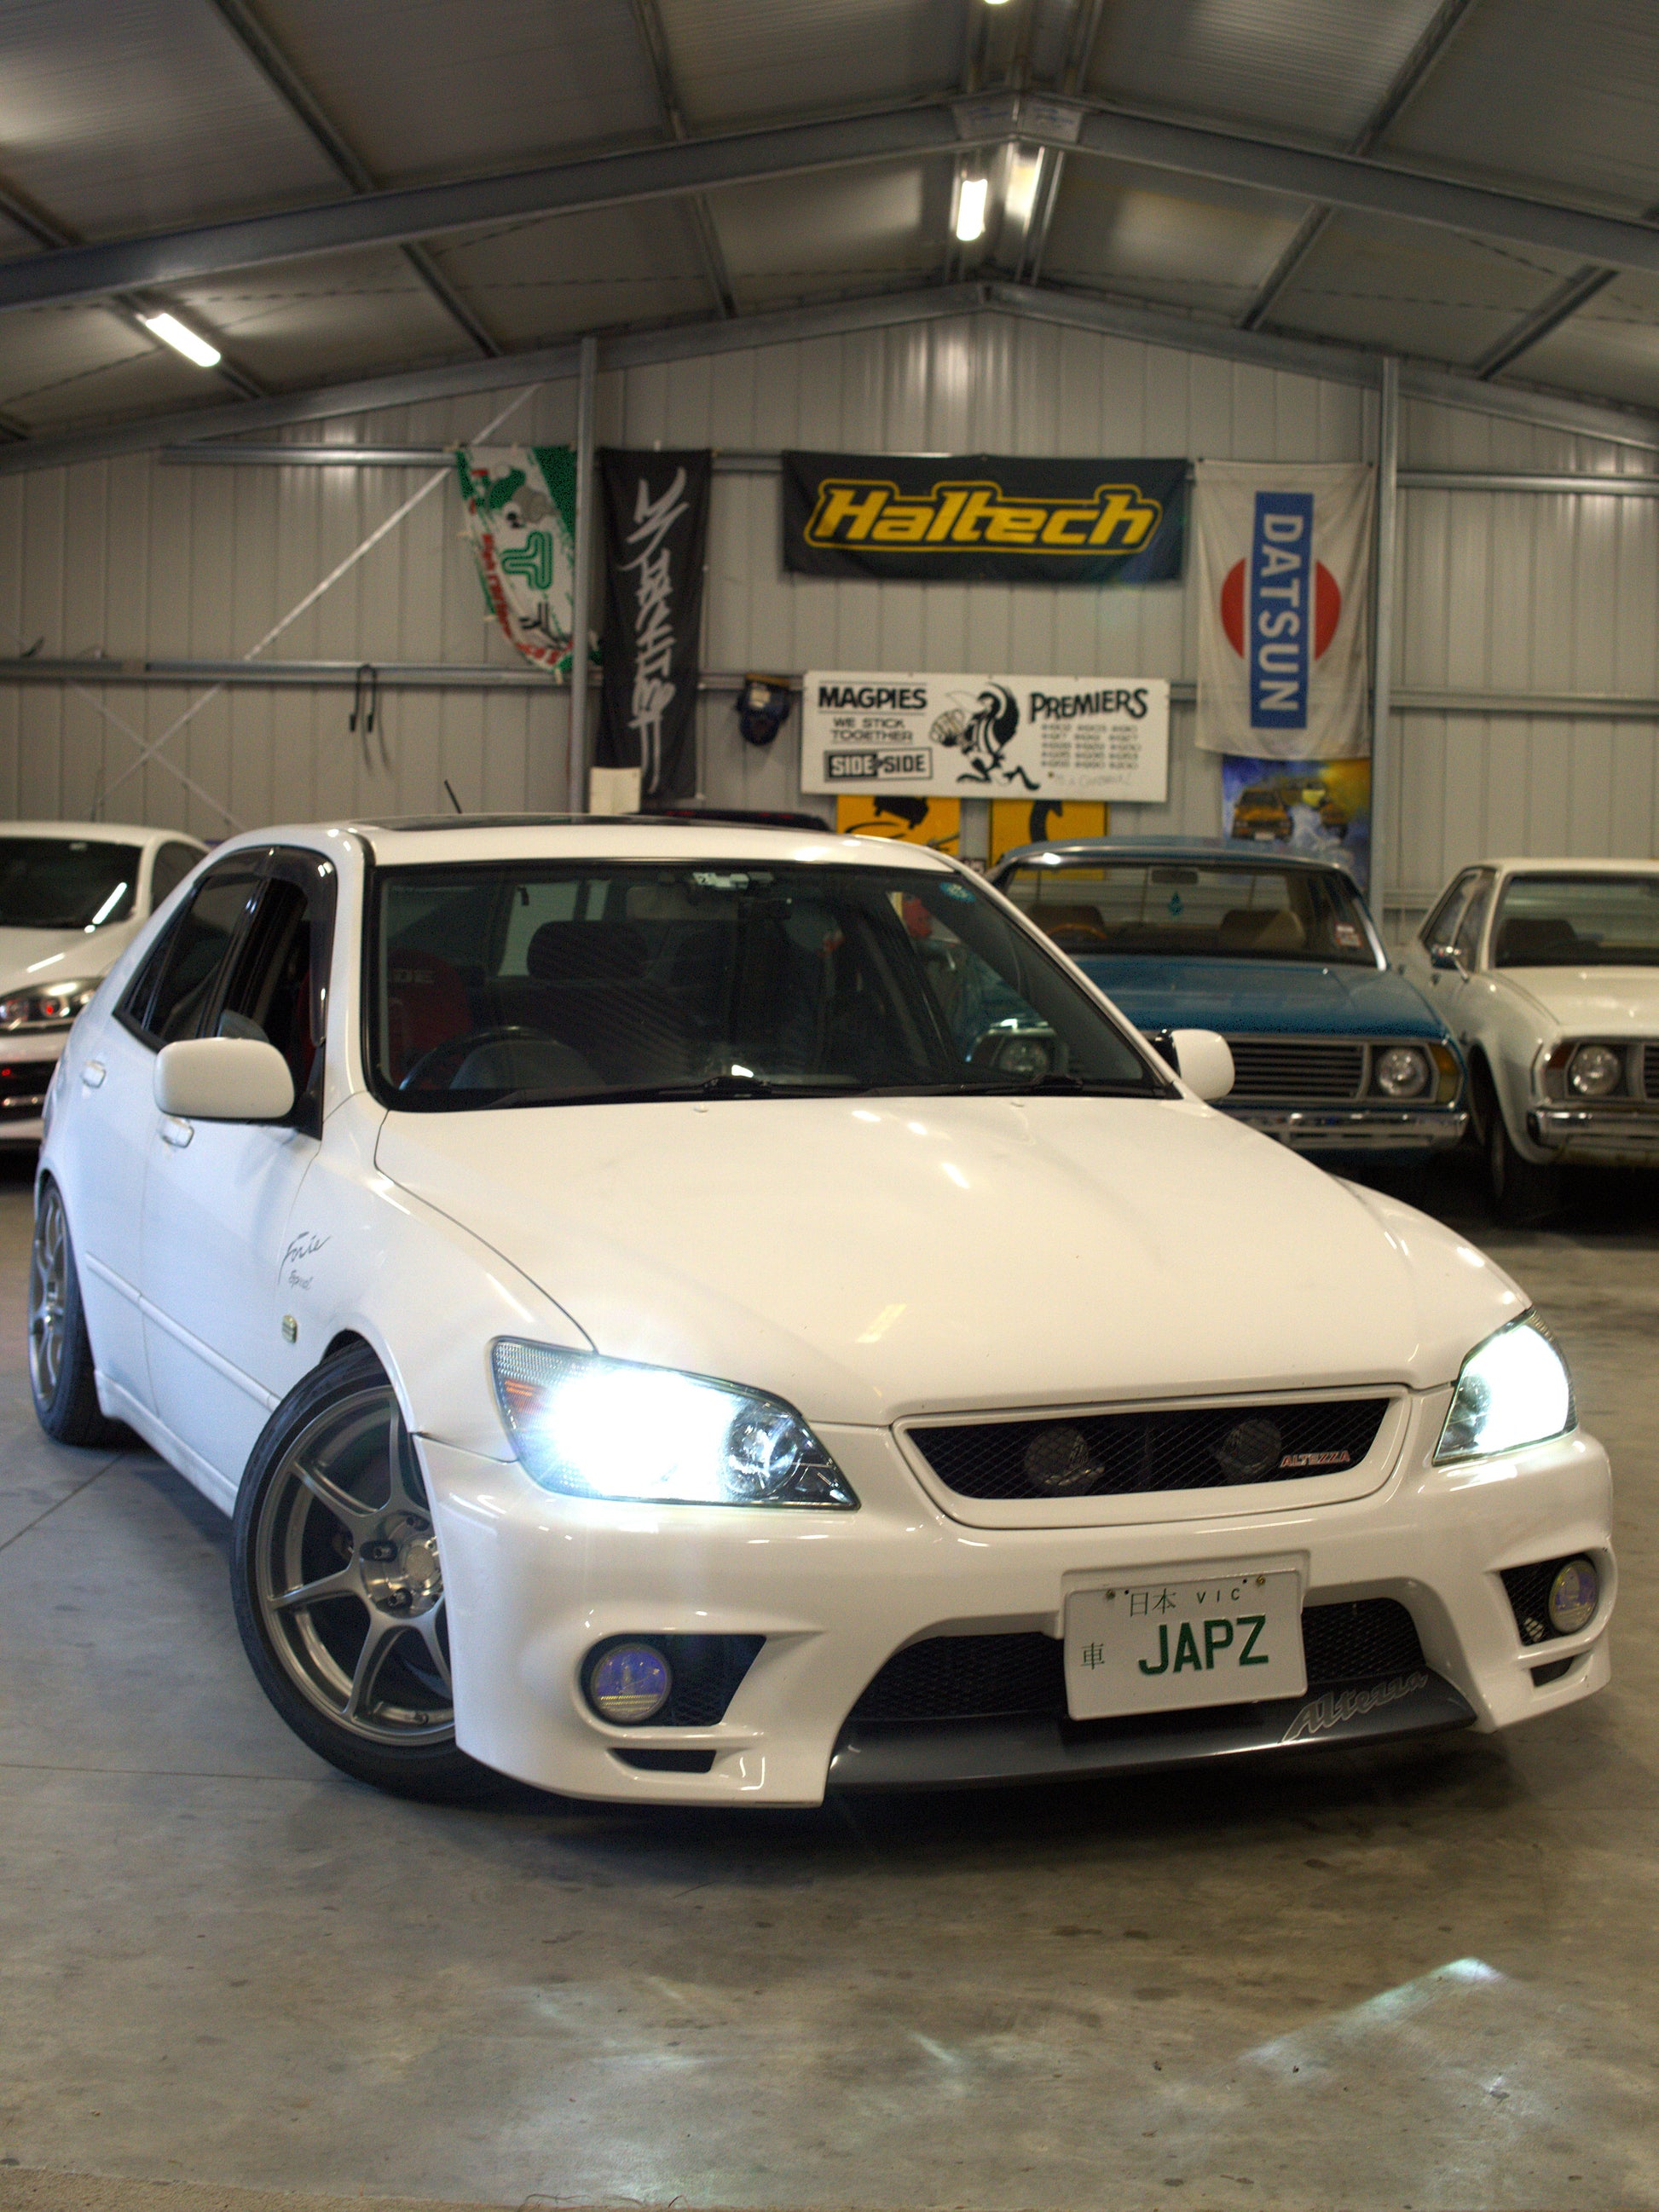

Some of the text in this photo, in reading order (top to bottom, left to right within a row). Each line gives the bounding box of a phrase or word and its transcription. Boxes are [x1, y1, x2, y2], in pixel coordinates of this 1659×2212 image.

[812, 488, 1154, 545] Haltech
[1257, 513, 1304, 711] DATSUN
[818, 685, 928, 709] MAGPIES
[1030, 687, 1149, 723] PREMIERS
[830, 729, 914, 741] TOGETHER
[833, 717, 905, 729] WE STICK
[830, 755, 875, 777] SIDE
[884, 754, 927, 774] SIDE
[1280, 1450, 1350, 1467] ALTEZZA
[1130, 1588, 1176, 1617] 日本
[1196, 1588, 1240, 1603] VIC
[1080, 1642, 1105, 1671] 車
[1138, 1614, 1269, 1675] JAPZ
[1281, 1670, 1430, 1742] Altezza
